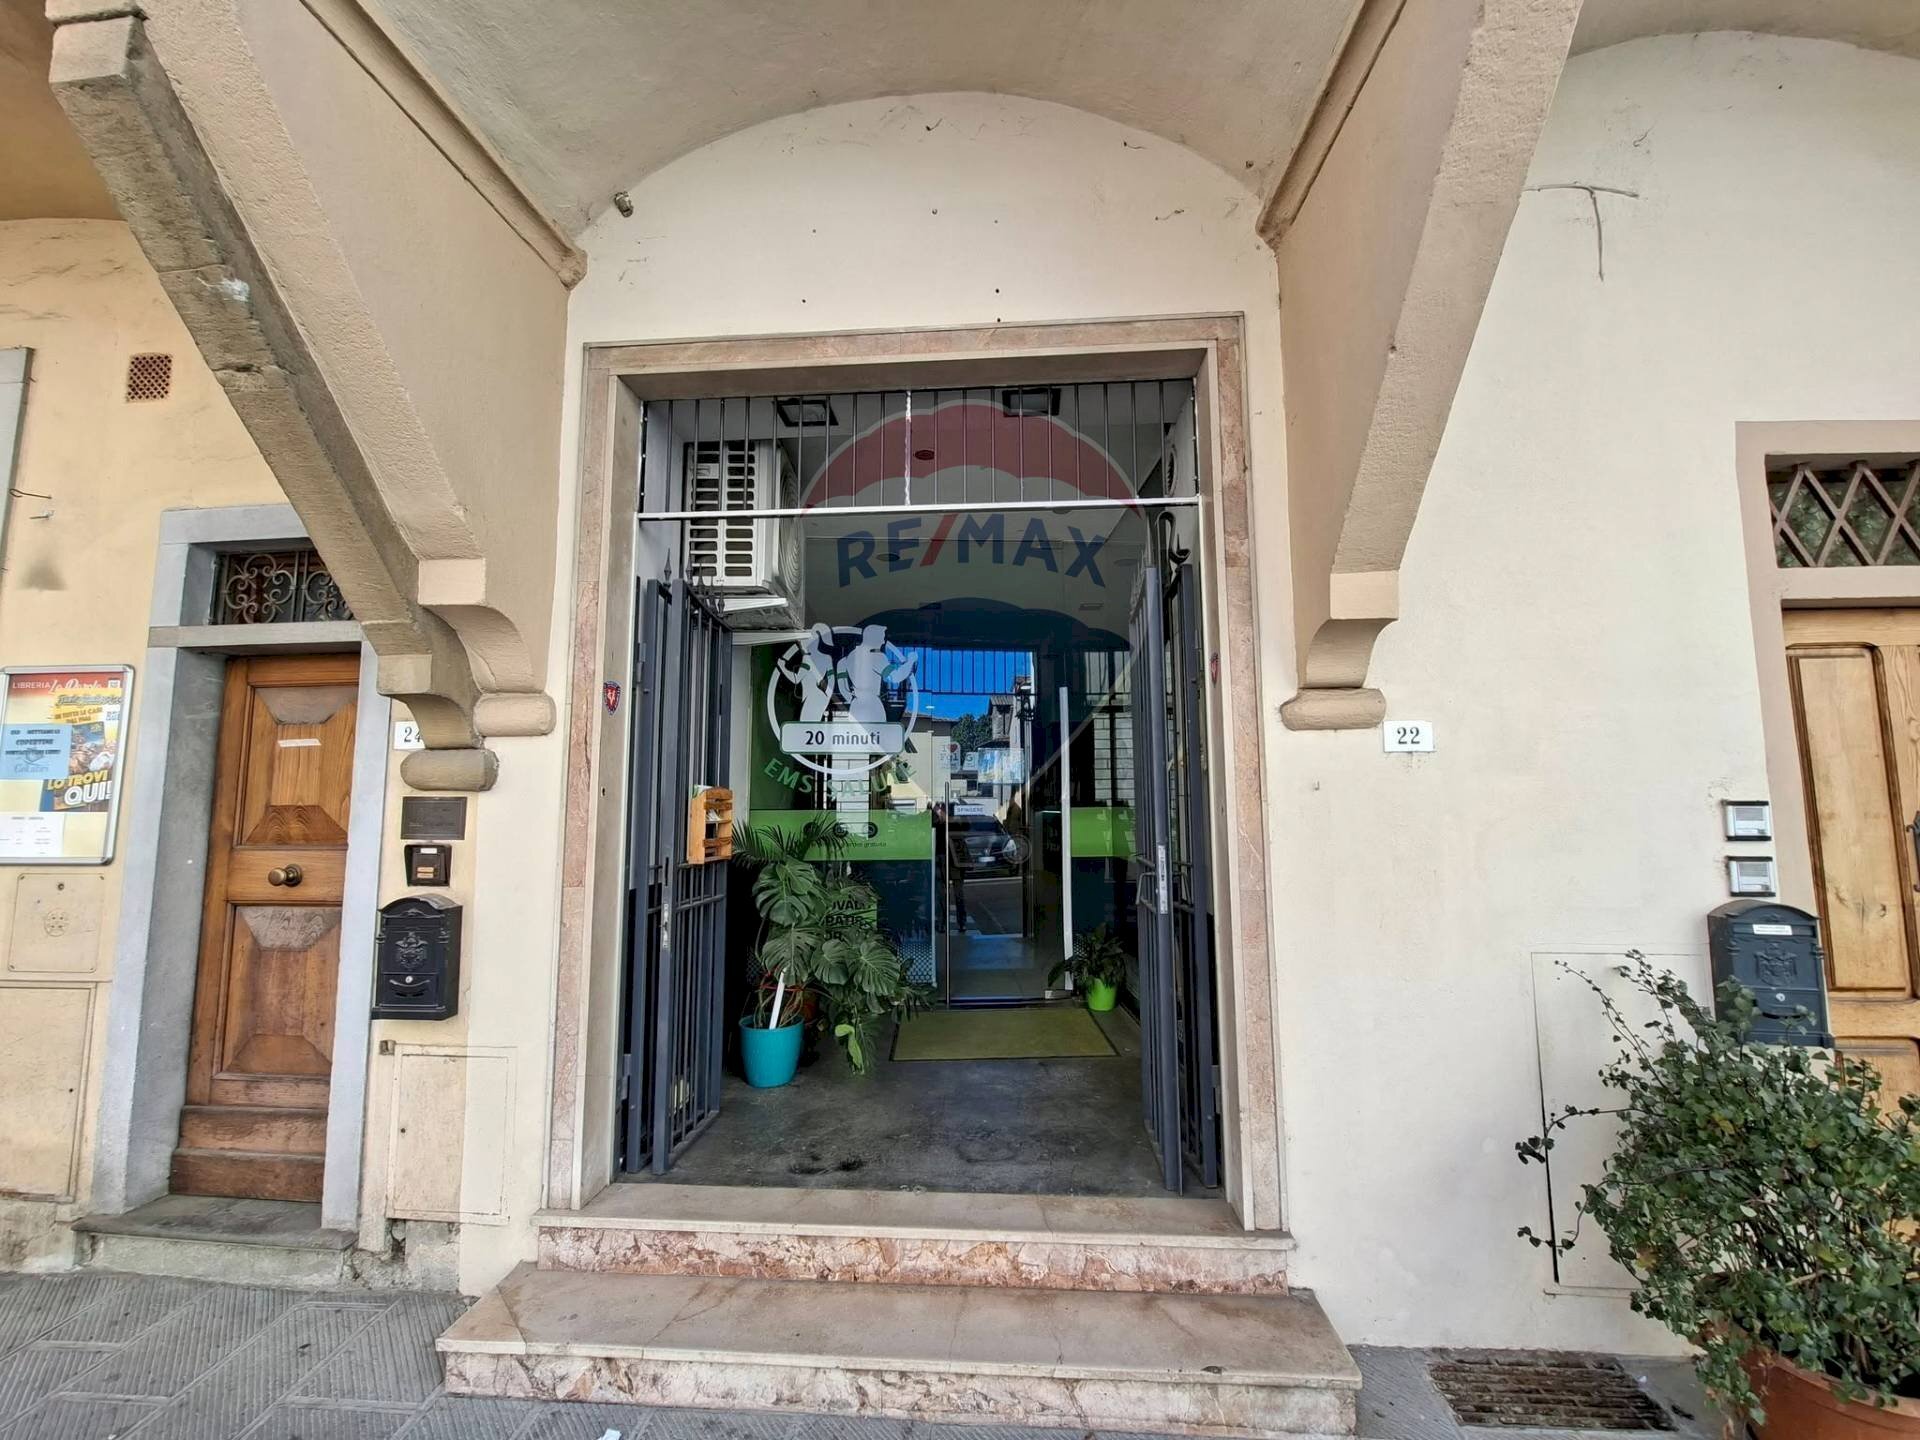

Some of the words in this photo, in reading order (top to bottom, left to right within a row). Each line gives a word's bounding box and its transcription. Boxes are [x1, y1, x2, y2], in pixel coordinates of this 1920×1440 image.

[12, 680, 50, 689] LIBRERIA
[805, 731, 825, 746] 20
[832, 731, 881, 746] minuti
[1397, 726, 1421, 745] 22
[47, 777, 64, 790] LO
[68, 769, 108, 787] TROVI
[764, 758, 814, 793] EMS
[826, 762, 917, 800] SALUTE
